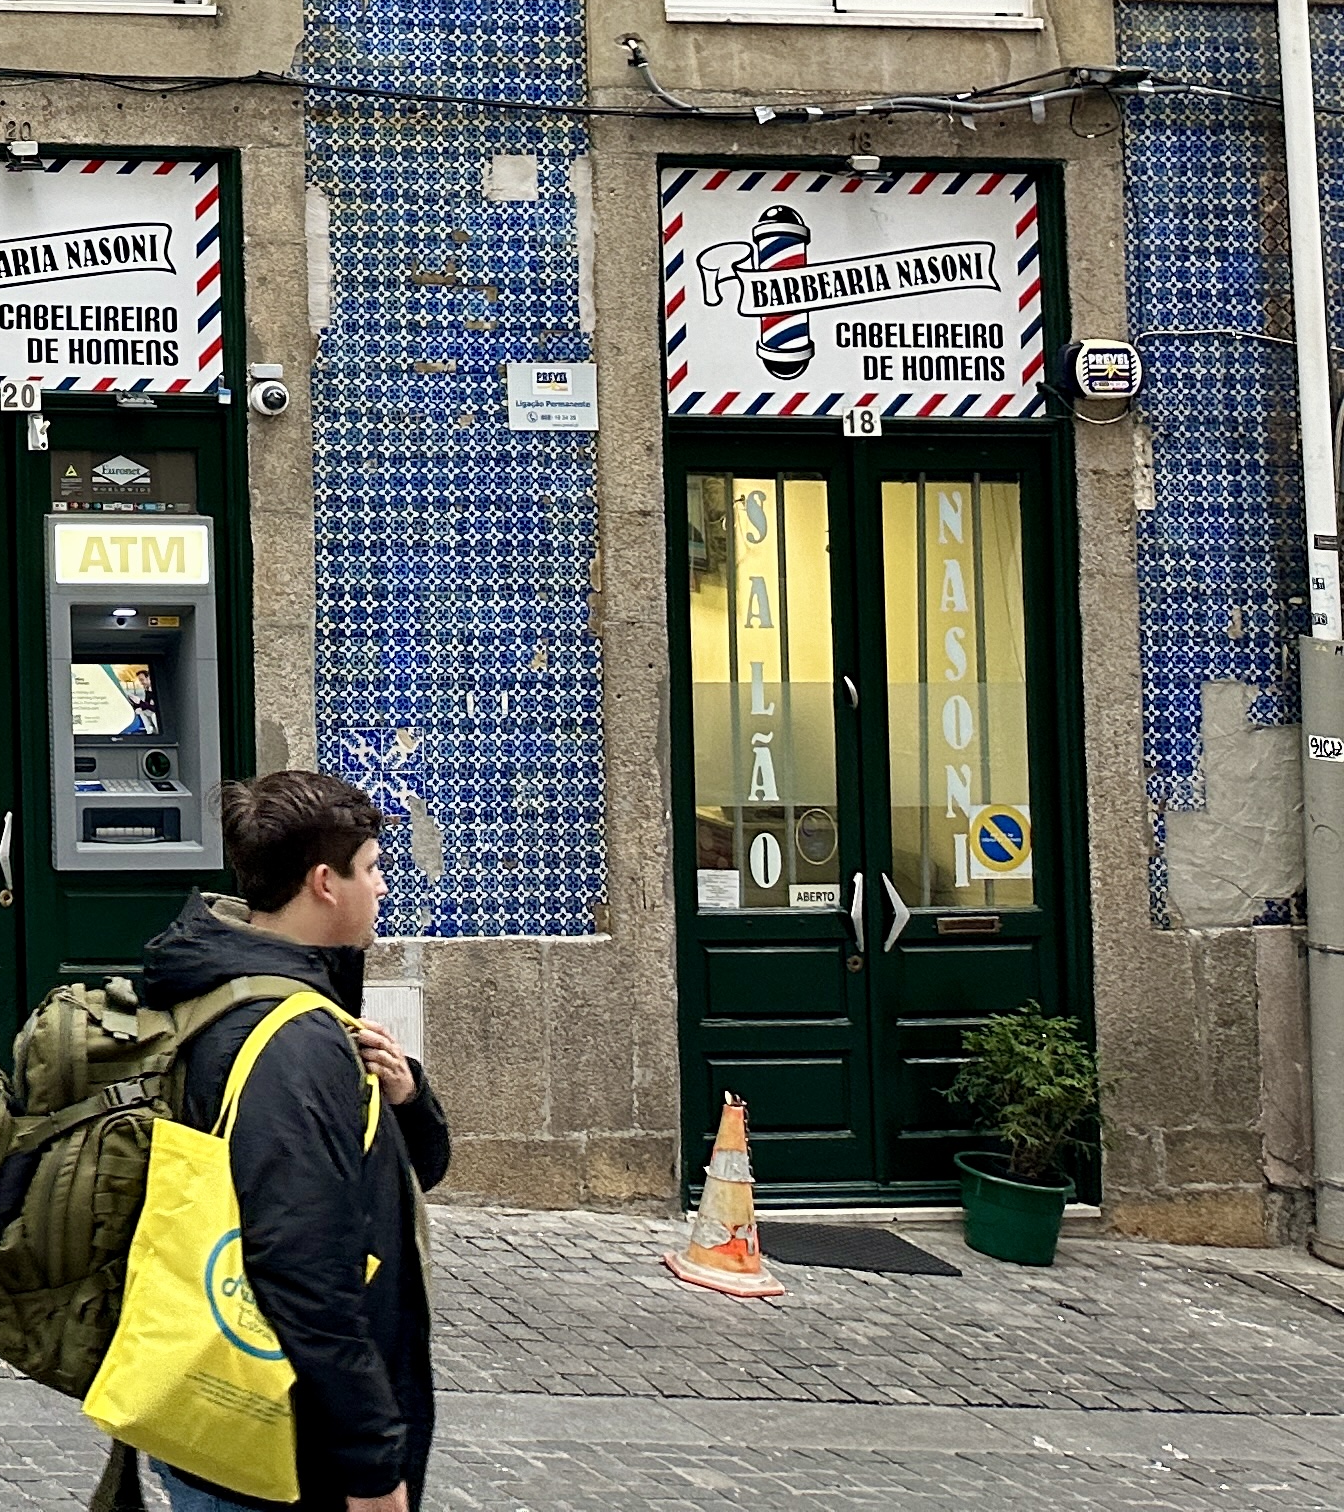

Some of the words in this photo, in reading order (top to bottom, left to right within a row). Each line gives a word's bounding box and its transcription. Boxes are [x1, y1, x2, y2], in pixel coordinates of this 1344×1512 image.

[5, 120, 32, 141] 20
[67, 232, 158, 271] NASONI
[752, 263, 892, 309] BARBEARIA
[898, 251, 983, 289] NASONI
[835, 322, 1005, 349] CABELEIREIRO
[27, 338, 60, 364] DE
[69, 339, 180, 366] HOMENS
[1087, 353, 1130, 365] PREVEL
[863, 356, 895, 381] DE
[903, 355, 1006, 382] HOMENS
[3, 383, 36, 409] 20
[845, 411, 876, 434] 18
[101, 464, 141, 475] Euronet
[79, 535, 187, 574] ATM
[938, 490, 974, 888] NASONI
[796, 891, 835, 902] ABERTO
